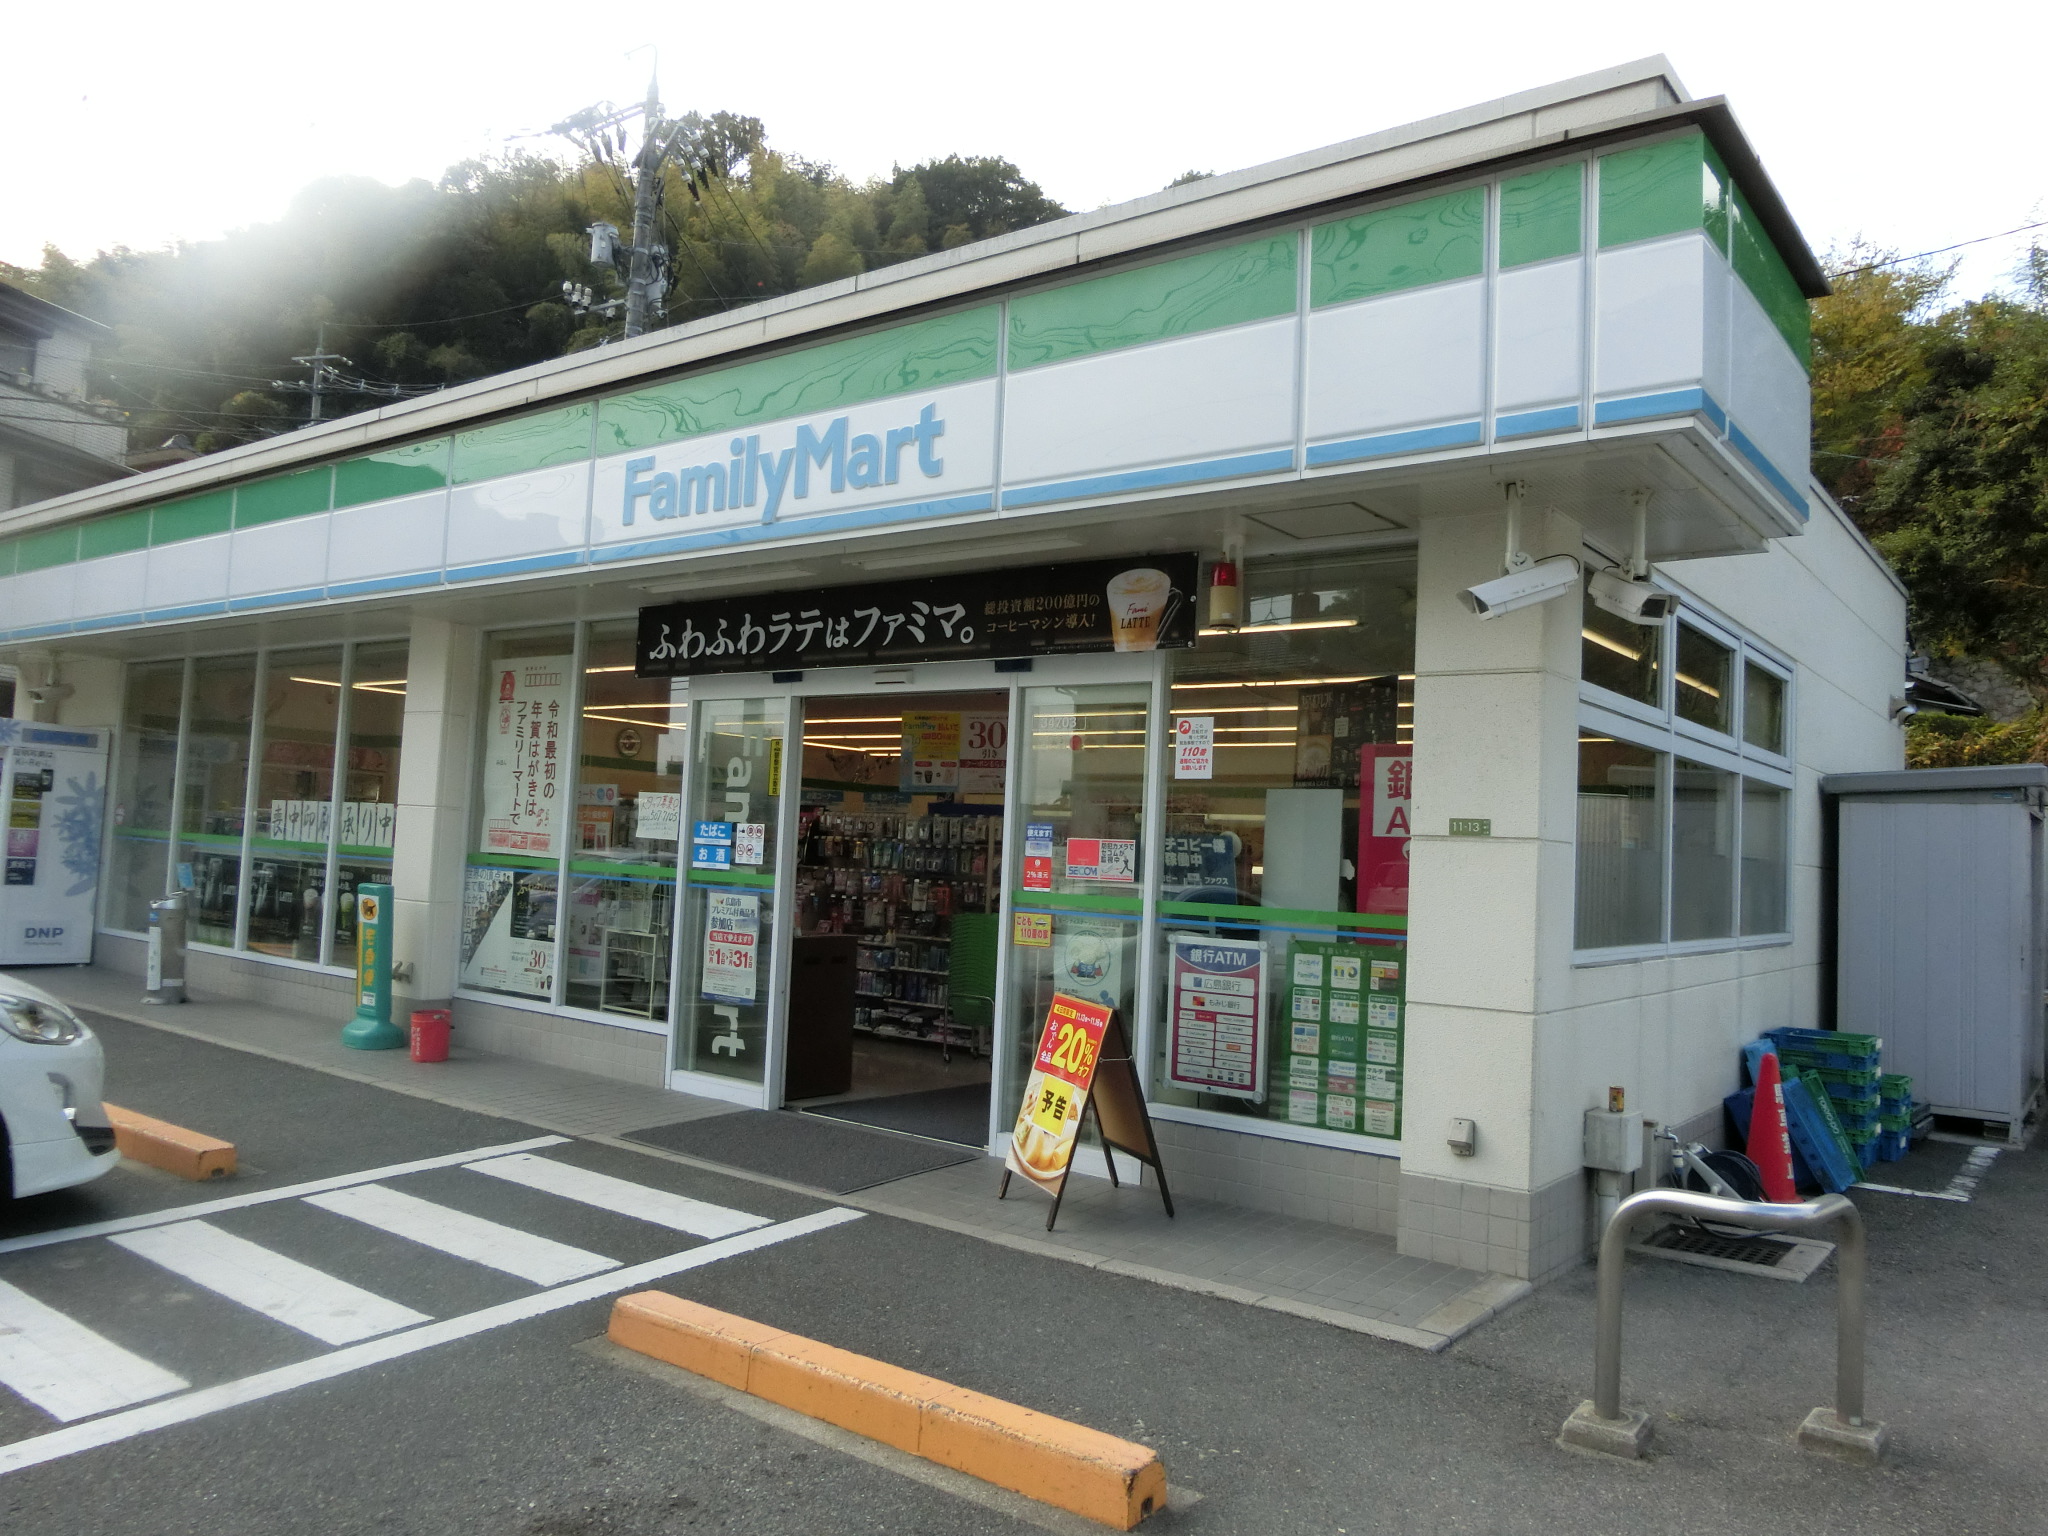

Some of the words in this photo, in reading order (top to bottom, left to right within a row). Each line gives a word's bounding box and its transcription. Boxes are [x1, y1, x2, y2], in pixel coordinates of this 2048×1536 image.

[622, 401, 944, 525] FamilyMart
[650, 602, 975, 661] ふわふわラテはファミマ。
[986, 613, 1096, 634] コーヒーマシン導入!
[1120, 616, 1151, 630] LATTE
[968, 721, 1008, 749] 30
[543, 699, 560, 798] 令和最初の
[509, 701, 528, 826] ファミリーマートで
[525, 700, 543, 817] 年賀はがきは
[700, 823, 726, 837] たばこ
[698, 847, 726, 862] お酒
[1068, 866, 1097, 876] SECOM
[711, 916, 733, 931] 参加店
[1016, 916, 1032, 926] こども
[25, 927, 64, 939] DNP
[529, 949, 546, 970] 30
[1190, 948, 1247, 967] 銀行ATM
[1203, 978, 1241, 993] 広島銀行
[1046, 1019, 1059, 1049] おでん
[1040, 1050, 1052, 1063] 全品
[1077, 1065, 1090, 1078] オフ
[1041, 1089, 1068, 1121] 予告
